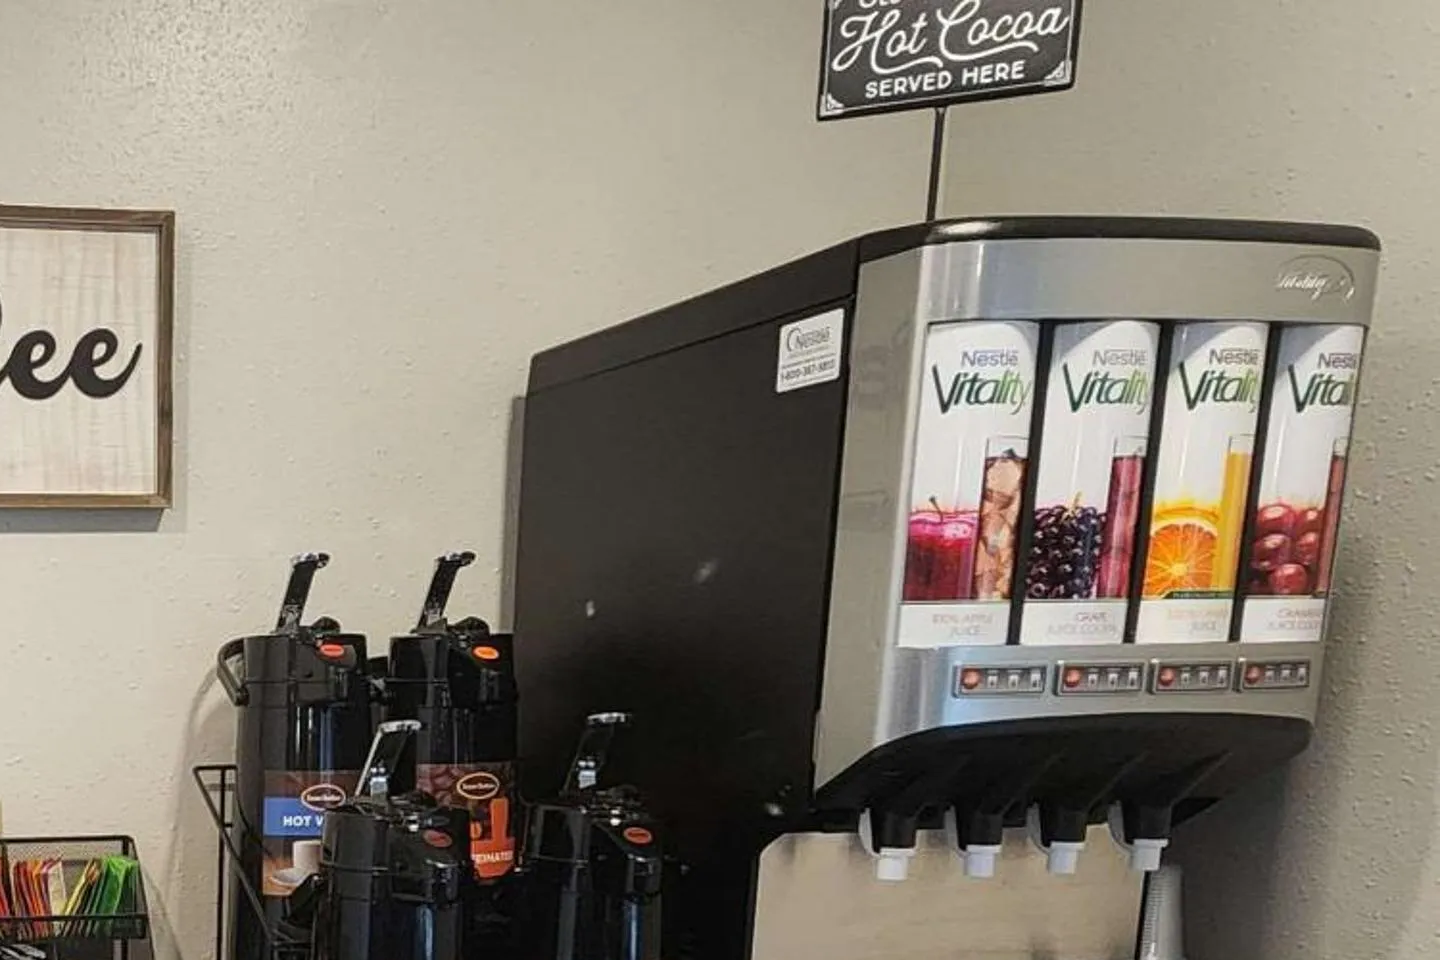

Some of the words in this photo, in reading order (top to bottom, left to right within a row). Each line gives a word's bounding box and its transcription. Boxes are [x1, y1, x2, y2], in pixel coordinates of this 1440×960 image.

[832, 9, 944, 74] Hot
[935, 0, 1070, 61] Cocoa
[864, 70, 953, 98] SERVED
[962, 60, 1026, 86] HERE
[932, 363, 1032, 416] Vitality
[283, 815, 312, 827] HOT
